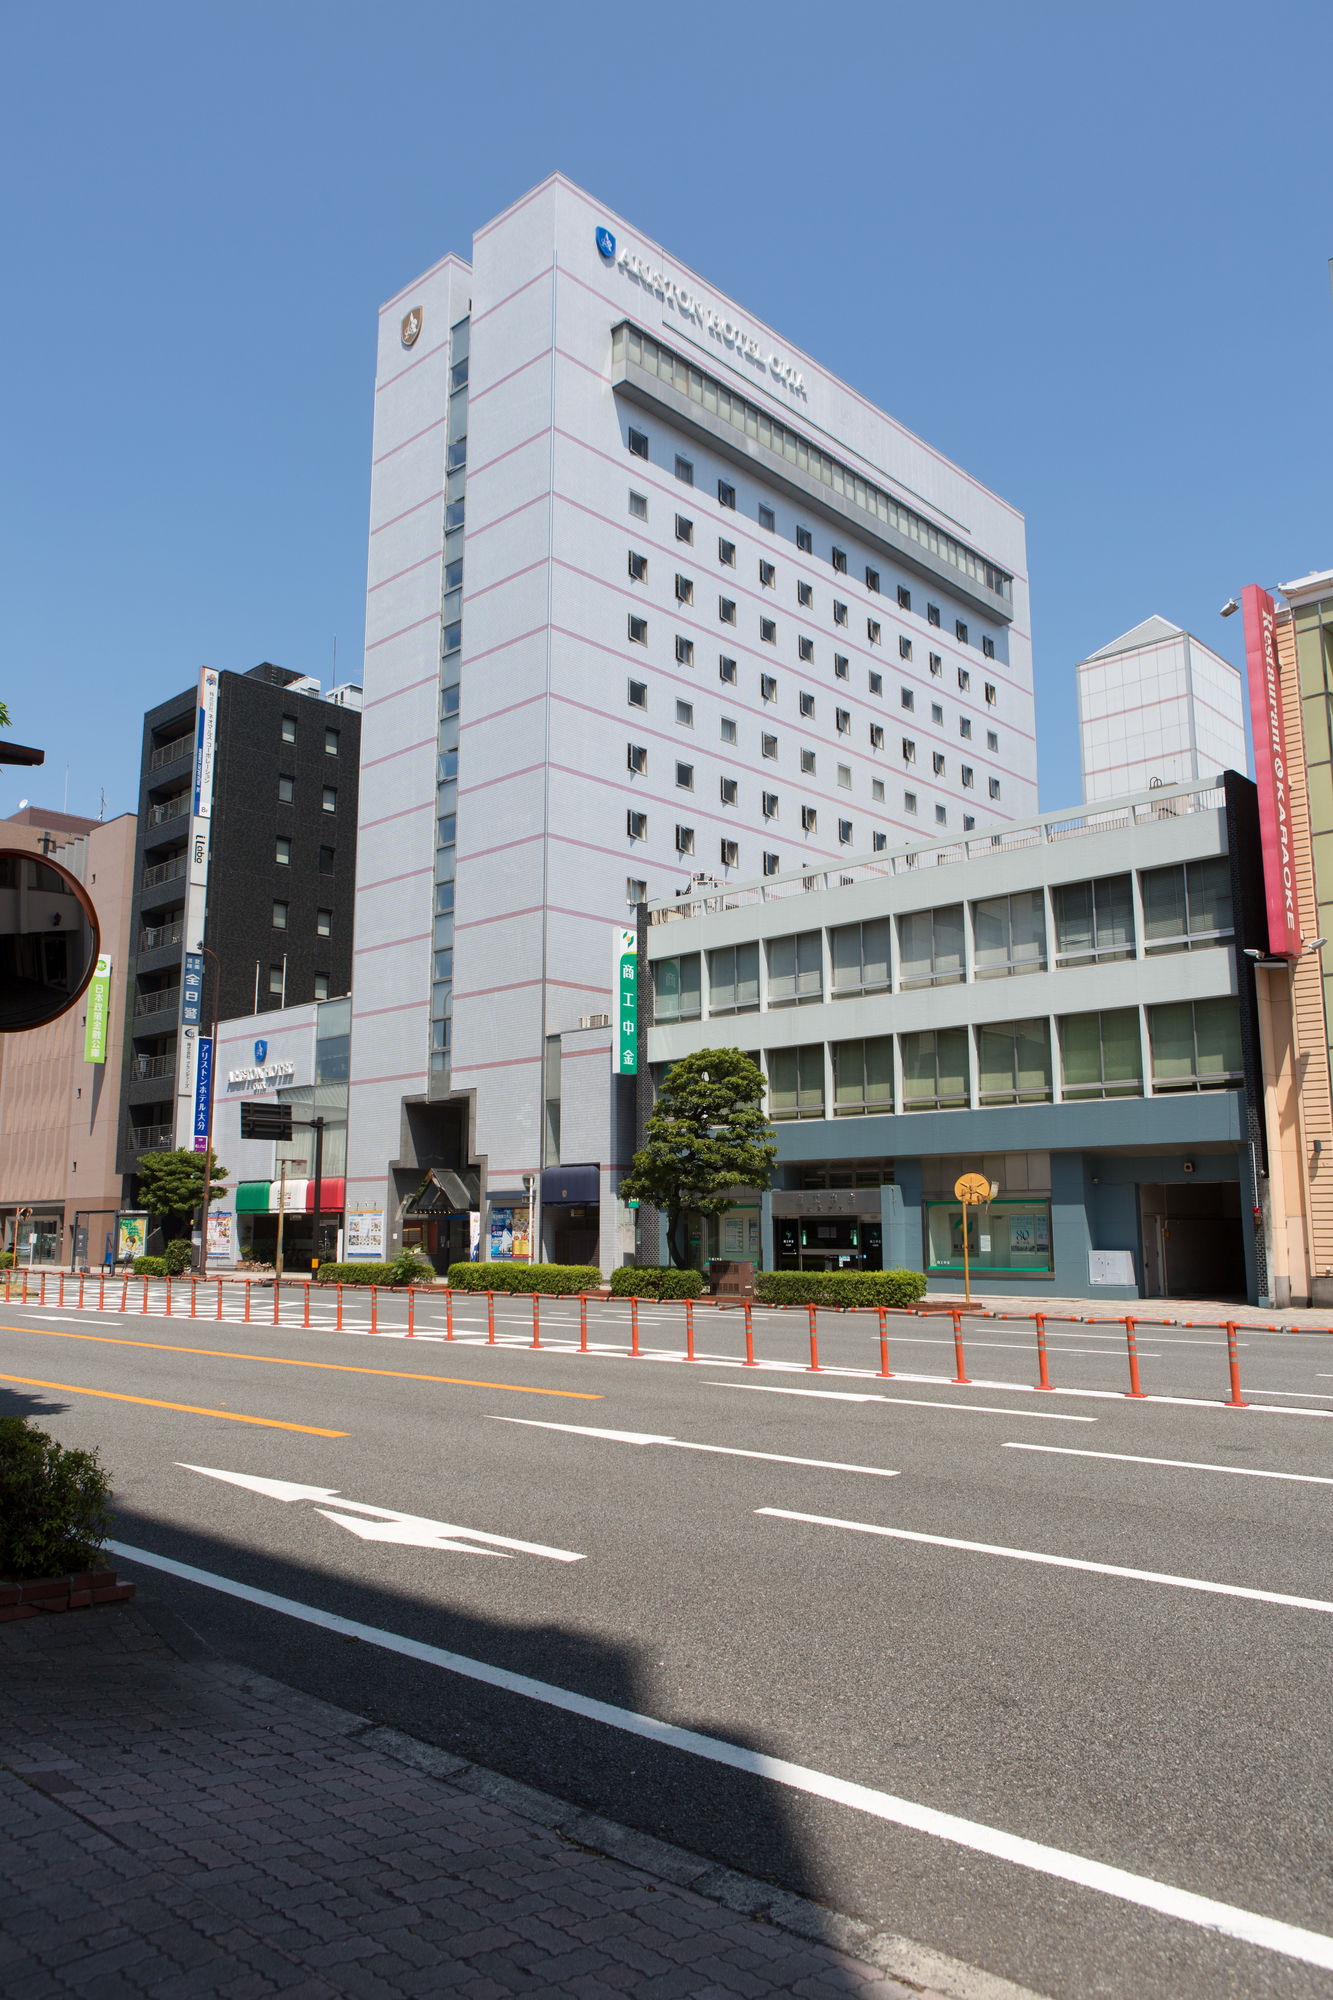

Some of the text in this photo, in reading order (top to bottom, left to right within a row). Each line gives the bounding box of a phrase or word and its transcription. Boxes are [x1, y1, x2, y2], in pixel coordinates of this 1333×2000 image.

[617, 246, 809, 402] ARISTON HOTEL OITA
[1262, 607, 1282, 753] Restaurant
[1276, 781, 1295, 930] KARAOKE
[184, 973, 200, 1019] 全日警
[622, 964, 635, 1066] 商工中金
[198, 1044, 209, 1130] アリストンホテル大分
